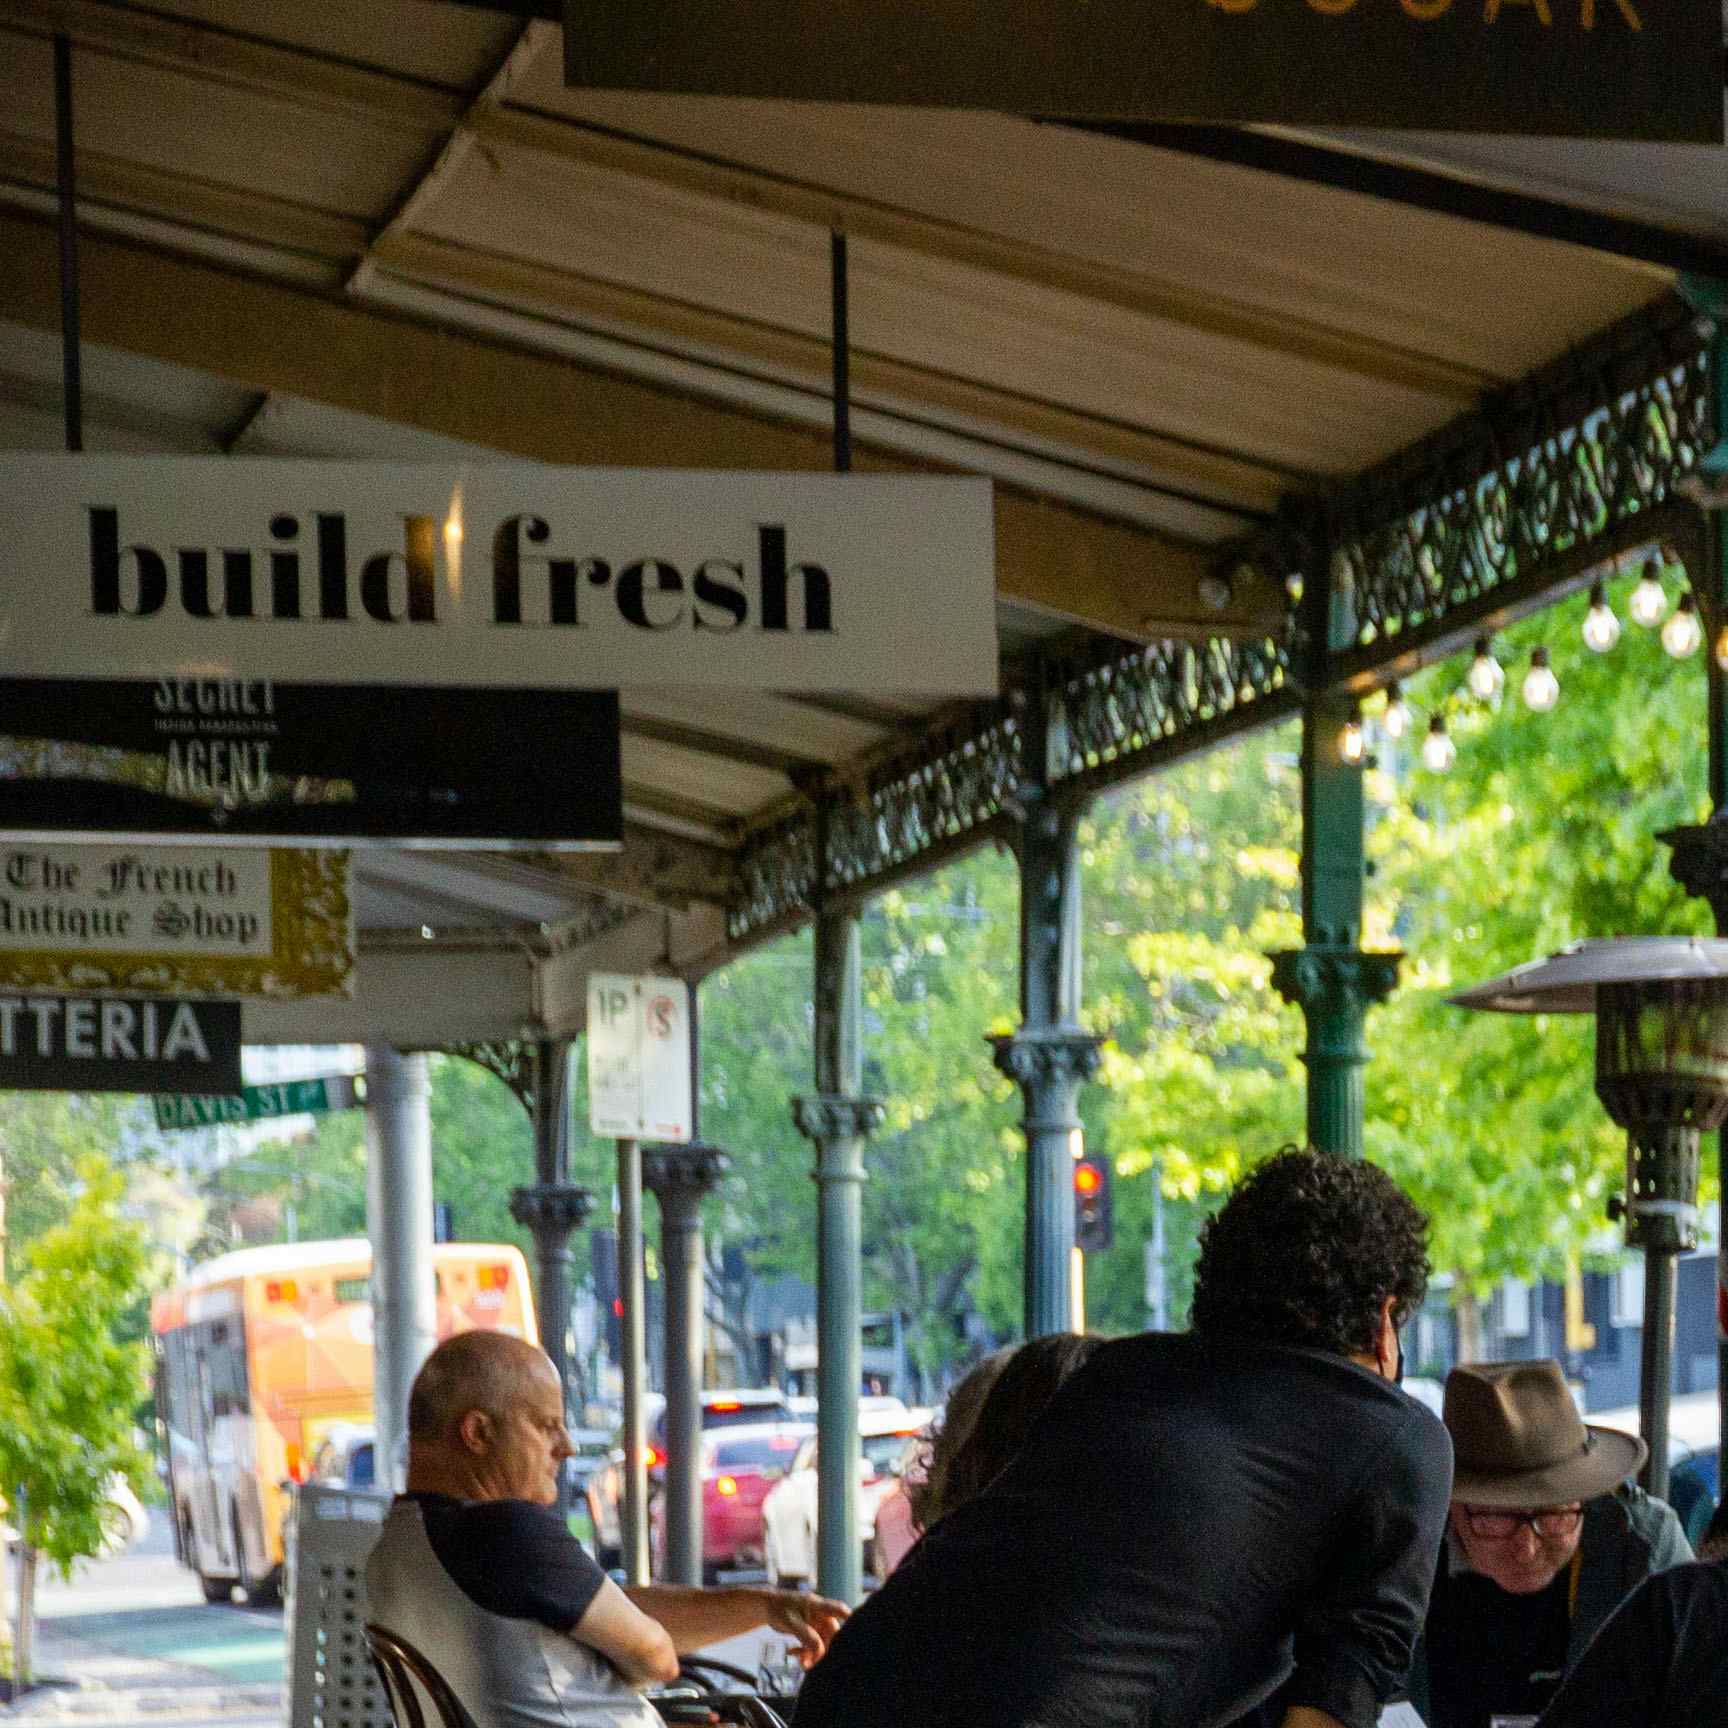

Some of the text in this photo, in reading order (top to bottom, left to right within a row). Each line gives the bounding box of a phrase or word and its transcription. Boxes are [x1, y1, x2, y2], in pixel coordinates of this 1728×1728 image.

[84, 504, 835, 635] build fresh
[165, 739, 272, 801] AGENT
[6, 853, 237, 899] The French
[152, 900, 258, 944] Shop
[0, 999, 212, 1062] TTERIA
